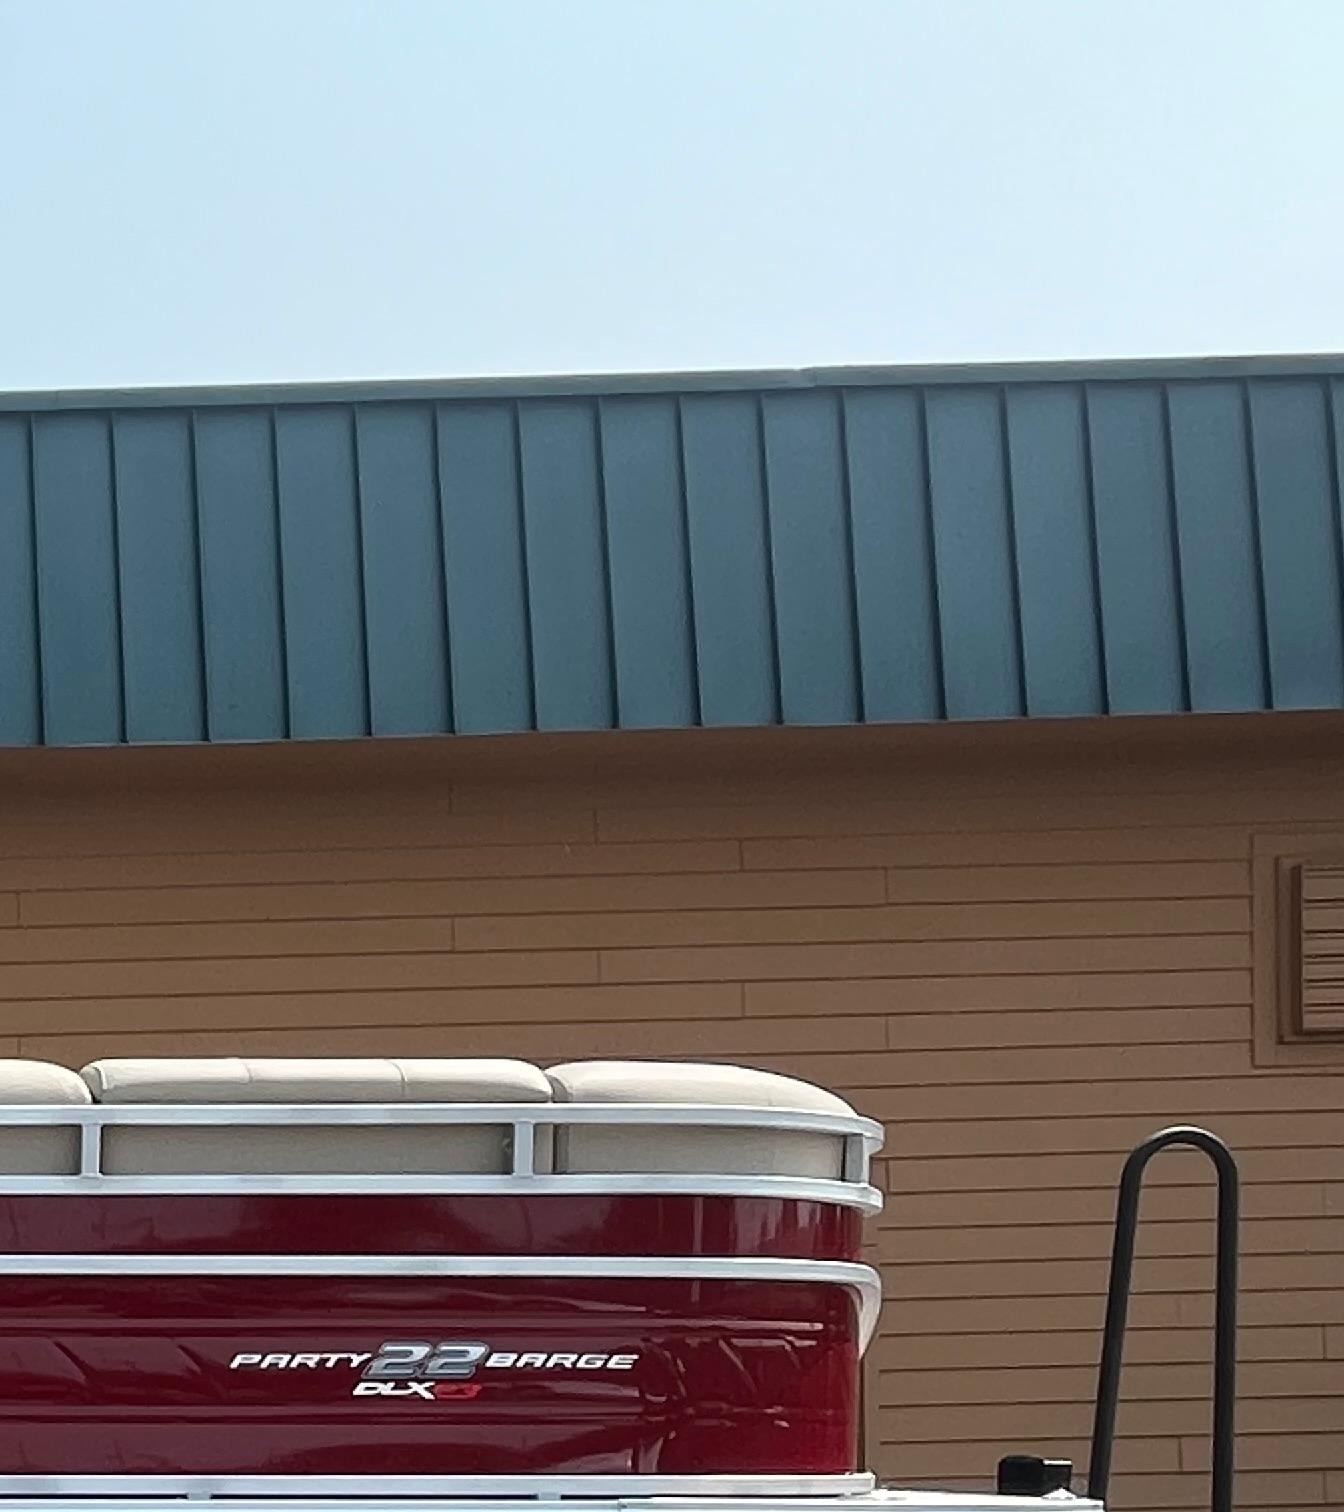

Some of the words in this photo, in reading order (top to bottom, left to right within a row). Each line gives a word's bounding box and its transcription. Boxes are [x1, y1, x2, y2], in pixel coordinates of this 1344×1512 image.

[229, 1352, 372, 1369] PARTY
[362, 1341, 490, 1380] 22
[485, 1353, 640, 1370] BARGE
